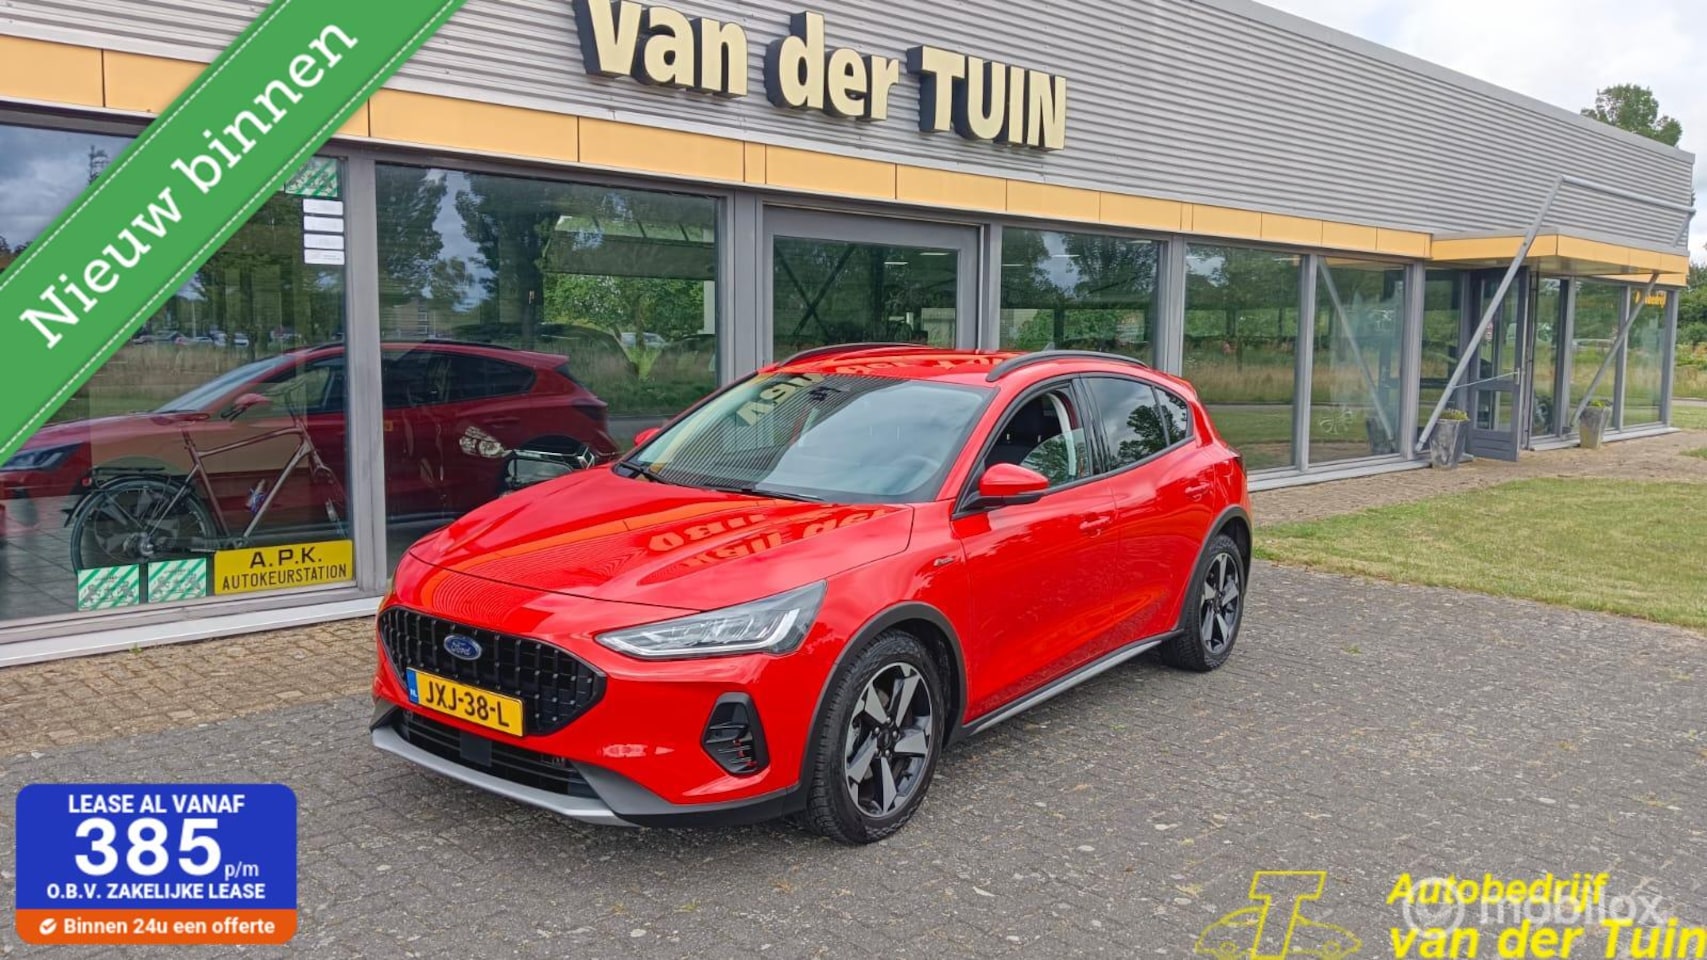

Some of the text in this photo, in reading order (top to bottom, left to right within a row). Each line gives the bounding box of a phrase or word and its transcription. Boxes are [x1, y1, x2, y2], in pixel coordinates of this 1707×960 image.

[585, 0, 1067, 151] van der TUIN
[250, 546, 322, 569] A.P.K.
[222, 564, 347, 591] AUTOKEURSTATION
[426, 680, 510, 728] JXJ-38-L
